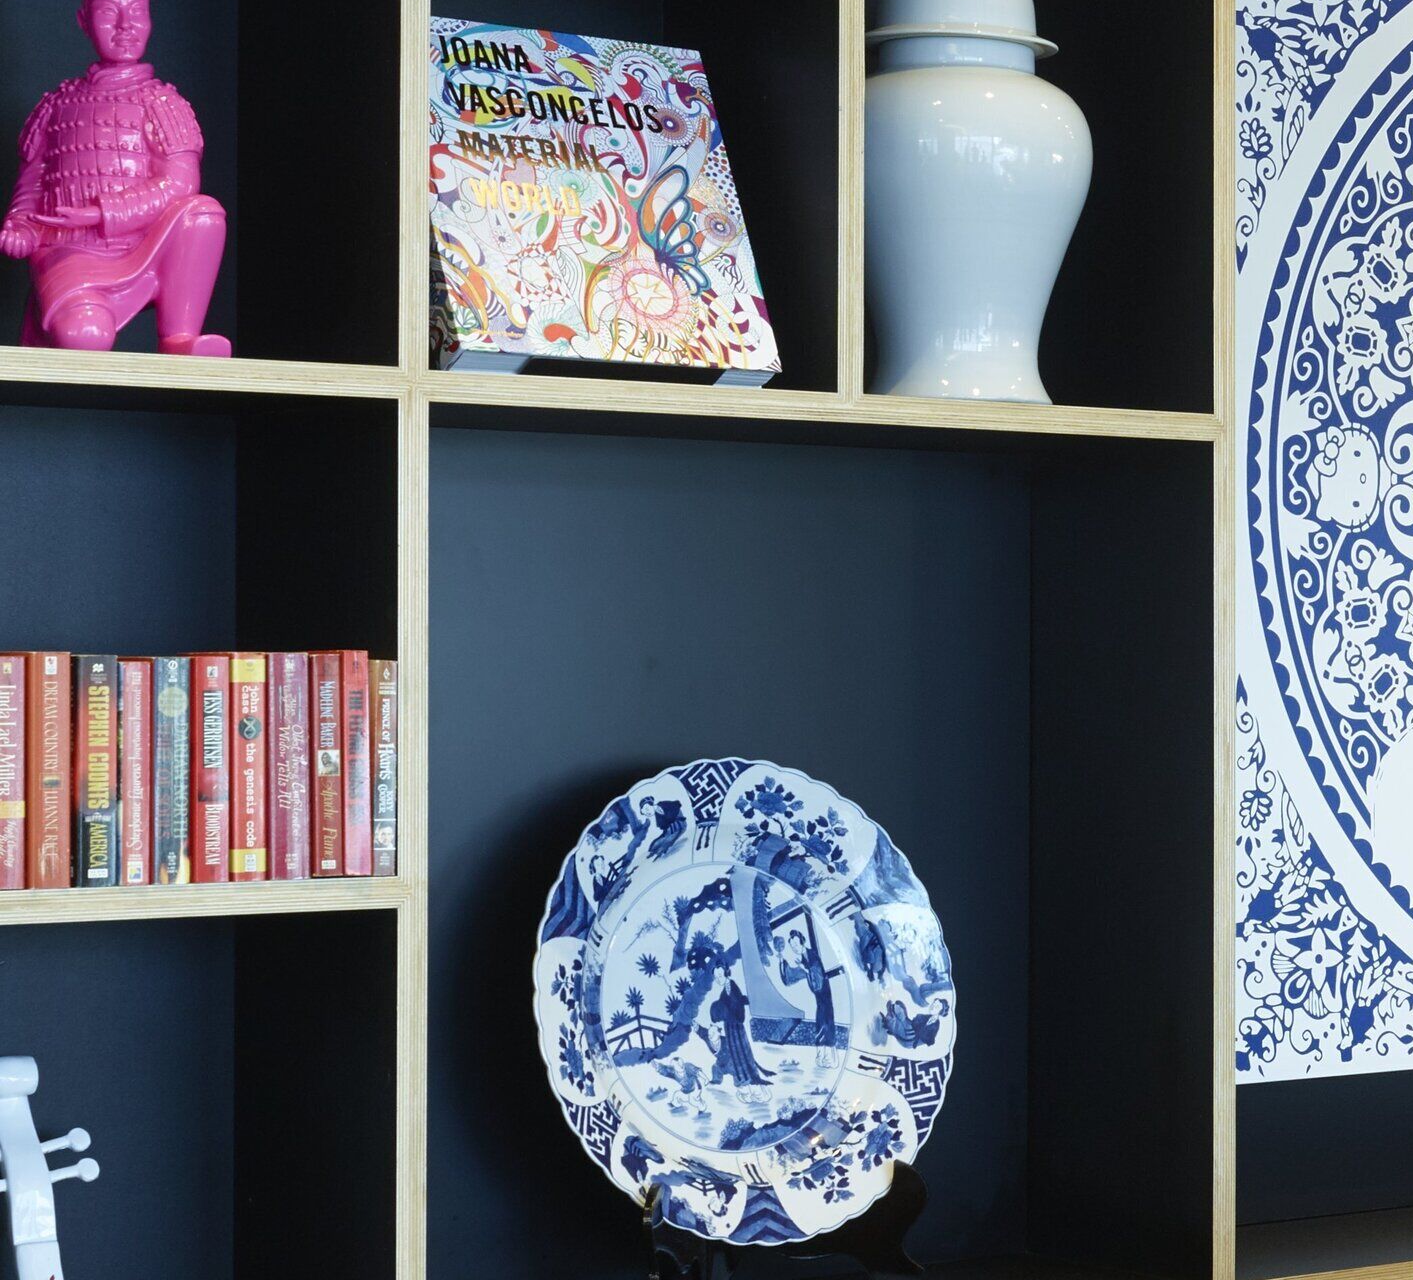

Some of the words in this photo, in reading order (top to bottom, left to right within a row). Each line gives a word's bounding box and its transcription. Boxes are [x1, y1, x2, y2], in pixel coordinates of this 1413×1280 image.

[438, 34, 533, 74] JOANA
[447, 82, 664, 135] VASCONCELOS
[456, 129, 610, 174] MATERIAL
[470, 178, 583, 218] WORLD
[0, 683, 17, 720] Linda
[44, 680, 59, 719] DREAM
[88, 685, 110, 747] STEPHEN
[203, 690, 224, 715] TESS
[242, 685, 250, 714] case
[250, 685, 260, 714] john
[320, 681, 337, 719] MADELINE
[382, 698, 391, 729] PRINCE
[0, 721, 17, 750] Lael
[44, 721, 59, 771] COUNTRY
[203, 715, 224, 769] GERRITSEN
[246, 743, 257, 762] the
[320, 722, 336, 749] BAKER
[382, 730, 391, 743] OF
[88, 752, 110, 809] COONTS
[377, 742, 397, 781] Hearts
[44, 790, 59, 829] LUANNE
[243, 768, 257, 815] genesis
[377, 783, 388, 815] COOPER
[387, 789, 395, 813] KATY
[90, 822, 109, 869] AMERICA
[126, 801, 143, 851] Stephanie
[205, 803, 224, 865] BLOODSTREAM
[246, 820, 256, 848] code
